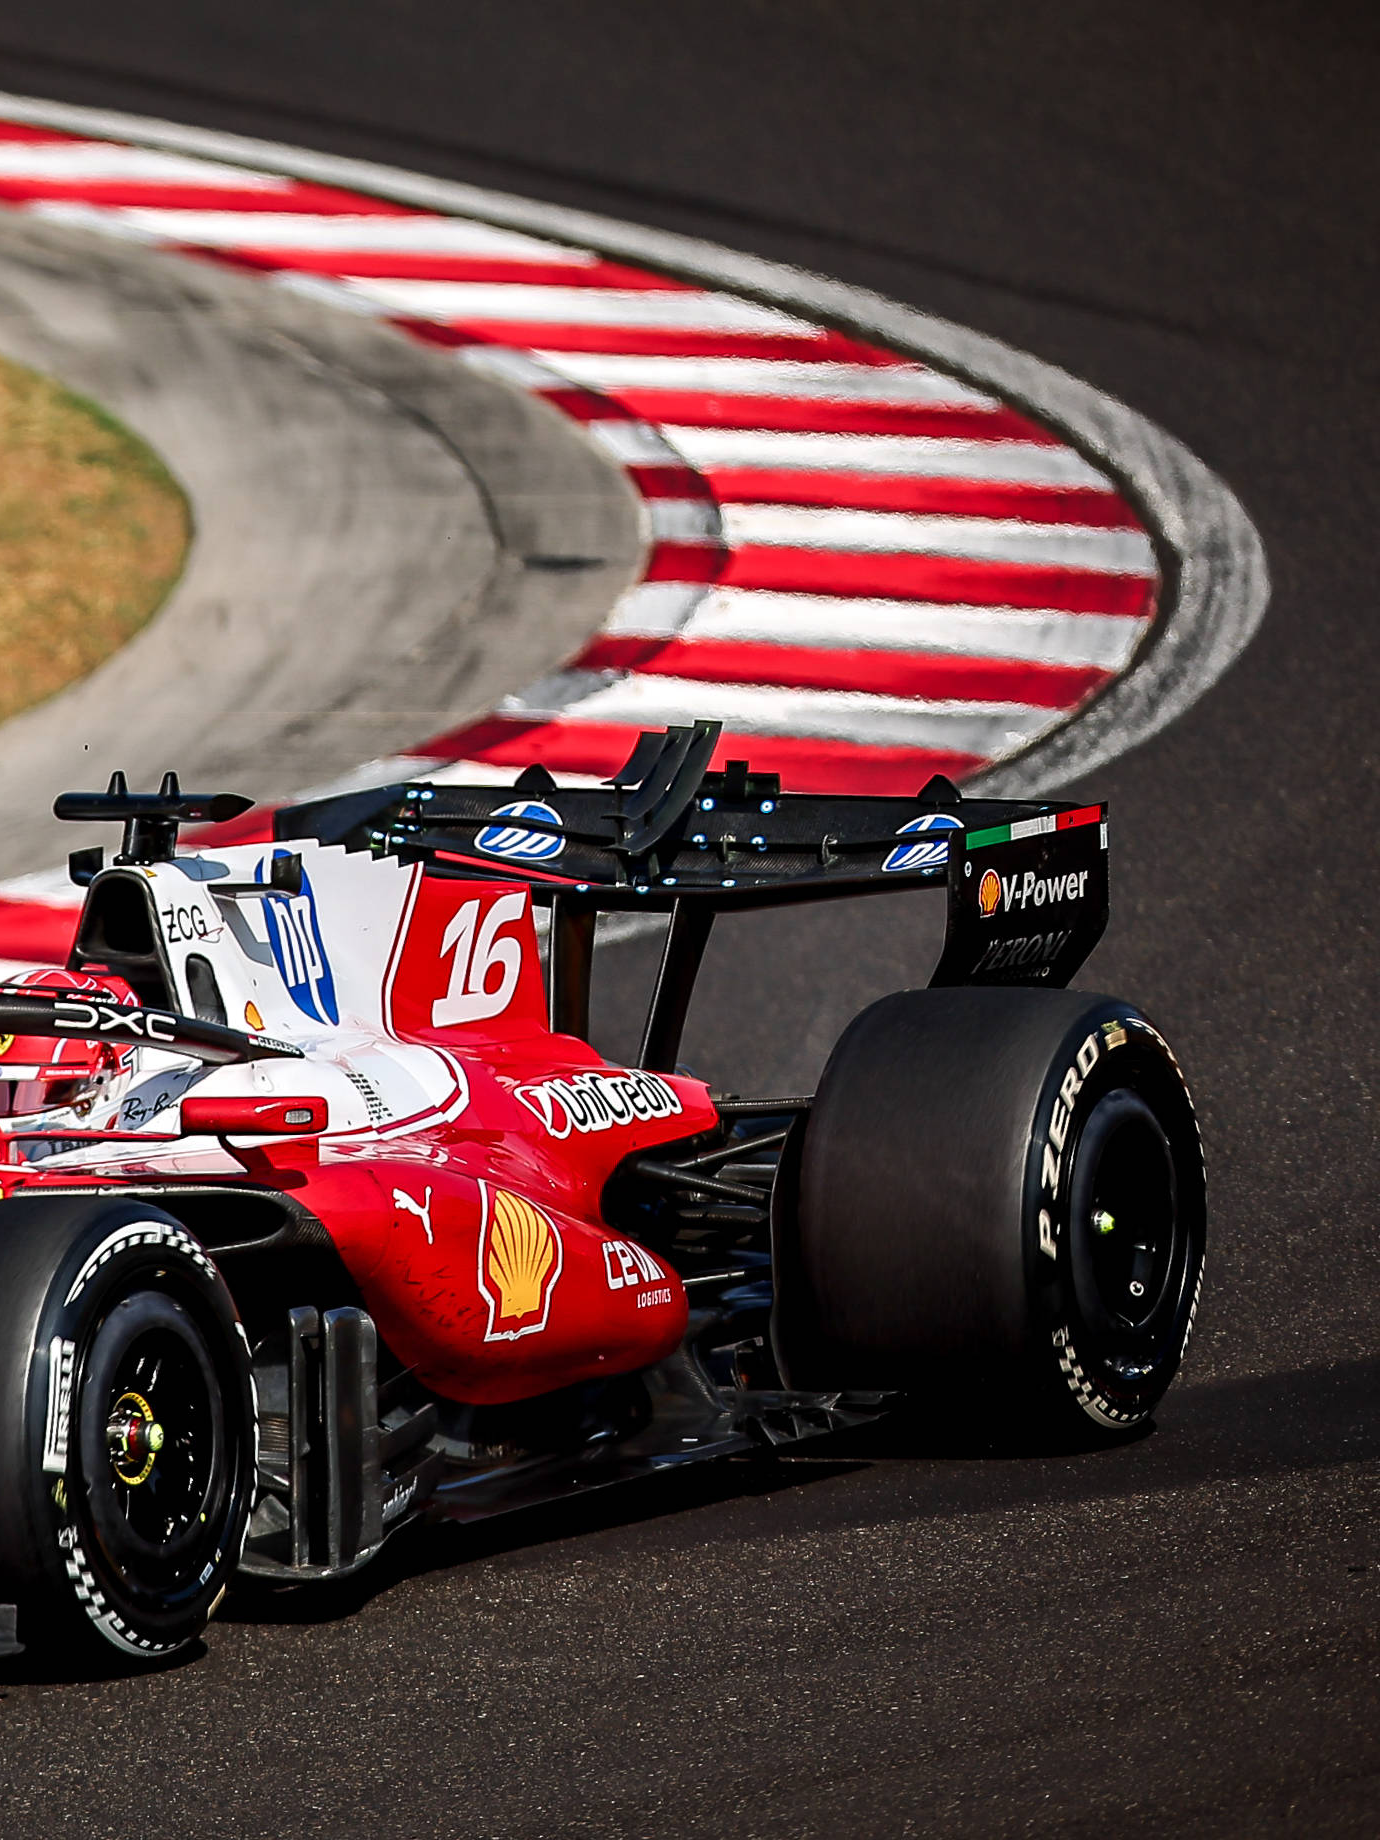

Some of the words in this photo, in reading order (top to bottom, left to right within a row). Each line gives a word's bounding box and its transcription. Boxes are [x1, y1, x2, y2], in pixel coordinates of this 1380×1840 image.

[1002, 871, 1088, 912] V-Power
[161, 903, 208, 943] ZCG
[431, 890, 528, 1029] 16
[54, 1001, 176, 1041] DXC
[122, 1092, 179, 1122] Ray-Ban
[549, 1070, 681, 1130] UniCredit
[1041, 1034, 1100, 1200] ZERO
[1039, 1209, 1057, 1260] P
[637, 1288, 671, 1308] LOGISTICS
[43, 1335, 76, 1472] PIRELLI
